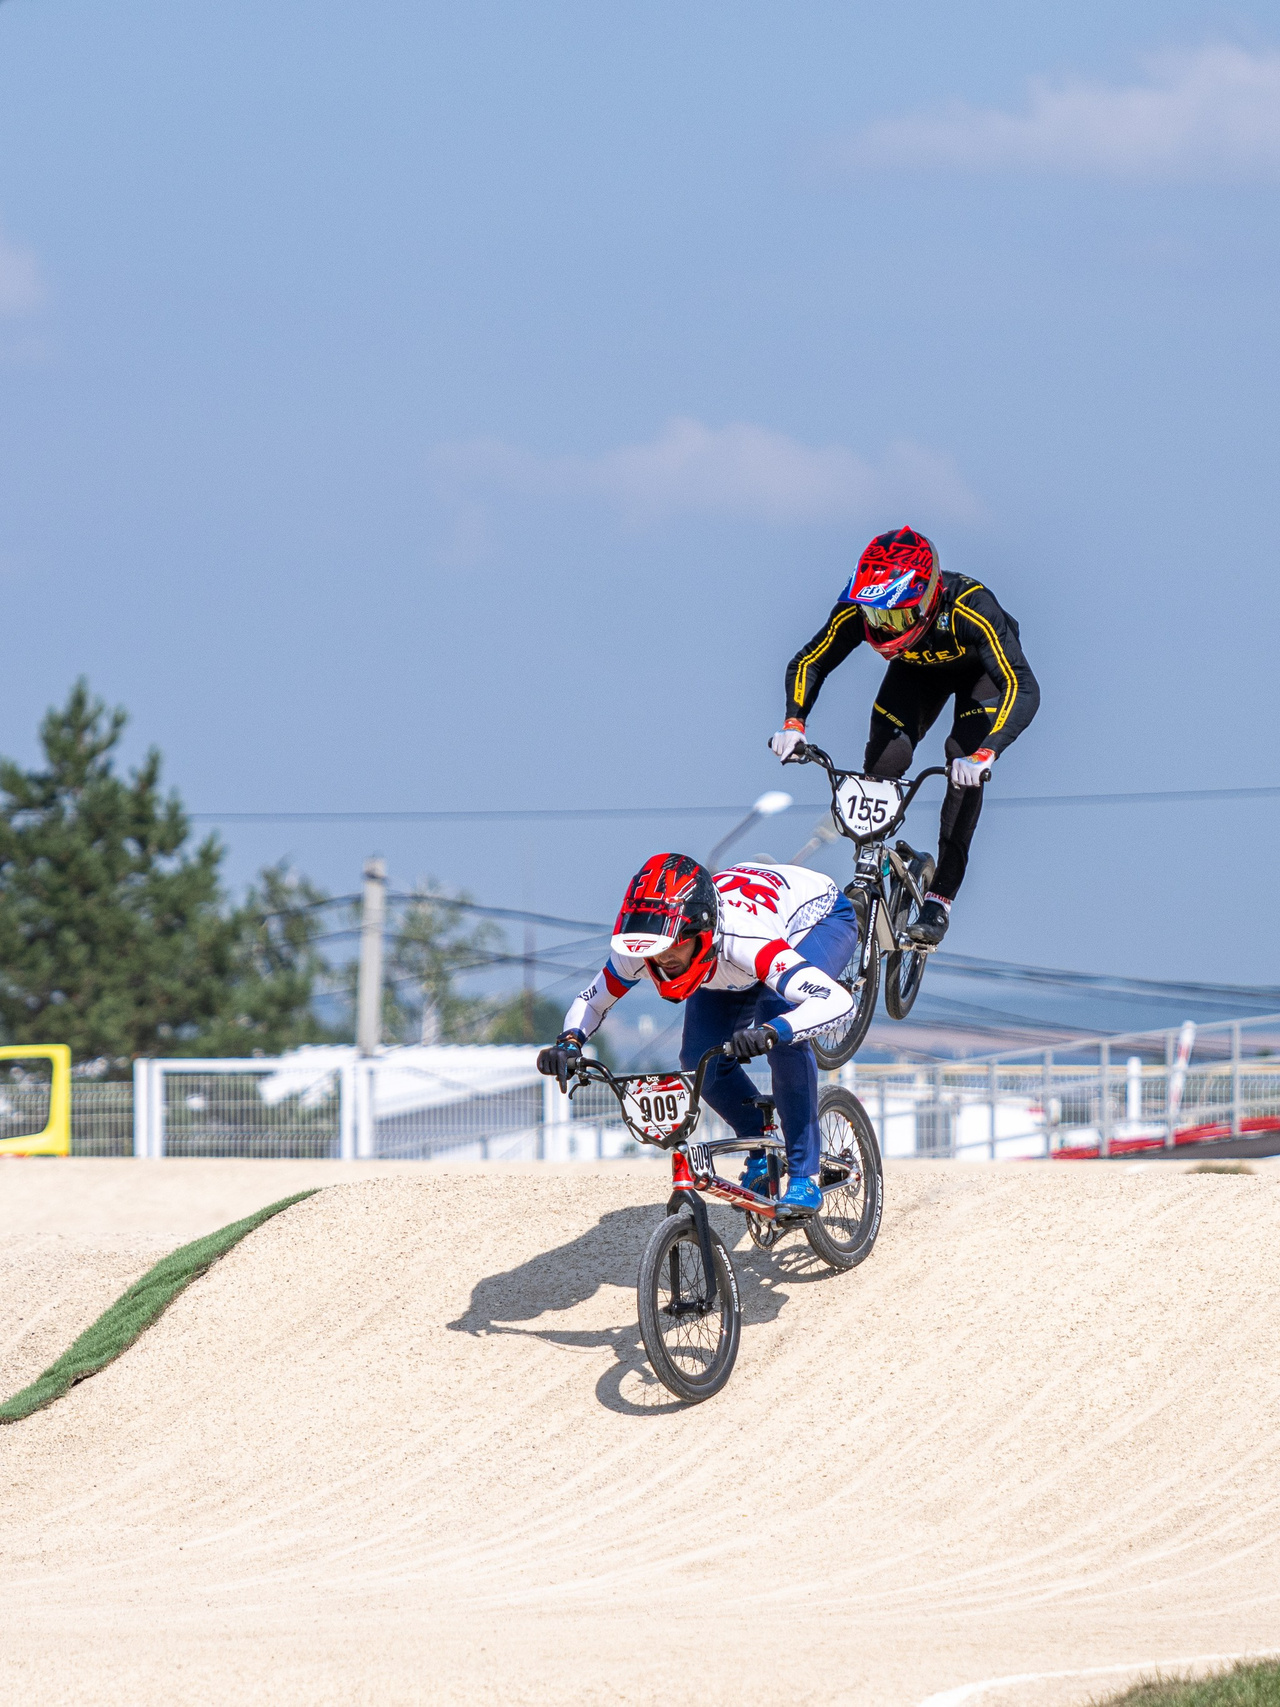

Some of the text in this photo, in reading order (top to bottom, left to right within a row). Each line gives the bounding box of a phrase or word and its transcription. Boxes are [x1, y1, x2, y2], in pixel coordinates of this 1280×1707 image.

[846, 795, 888, 823] 155
[867, 899, 878, 944] ANSWER
[639, 1094, 679, 1123] 909
[690, 1142, 711, 1172] 909
[716, 1244, 732, 1272] FASTR
